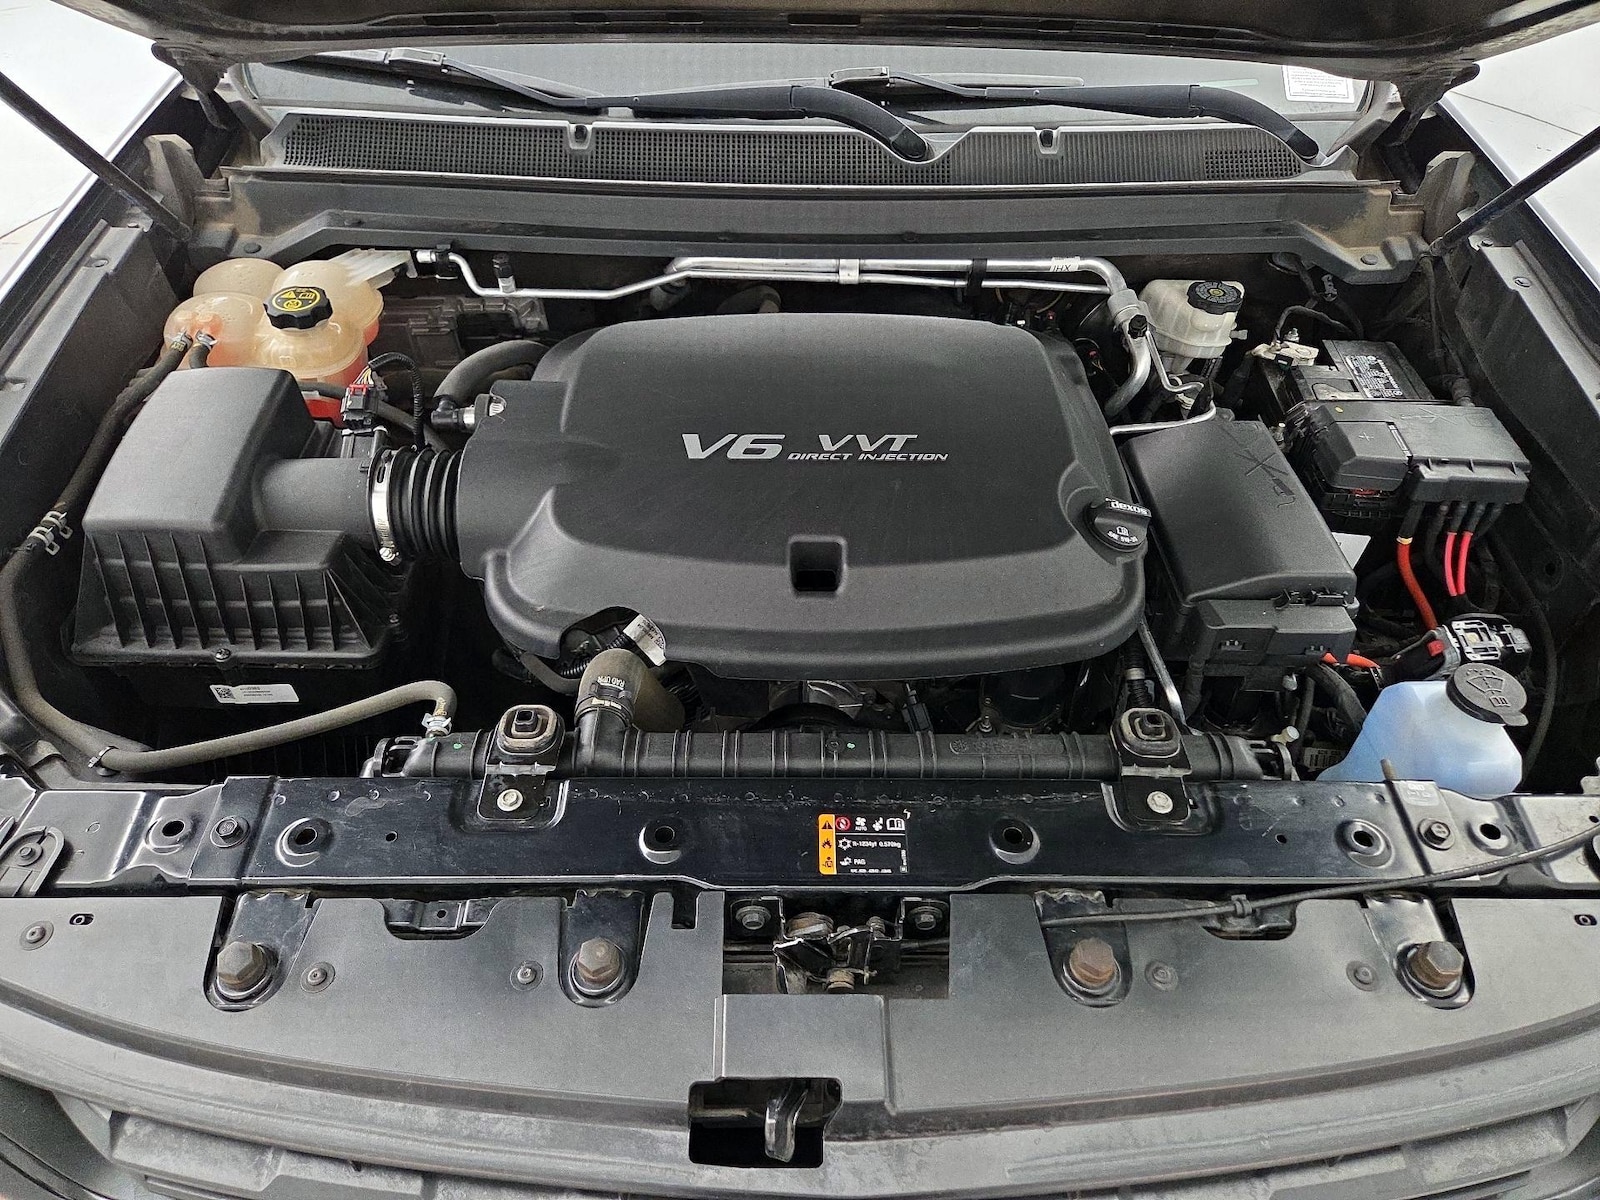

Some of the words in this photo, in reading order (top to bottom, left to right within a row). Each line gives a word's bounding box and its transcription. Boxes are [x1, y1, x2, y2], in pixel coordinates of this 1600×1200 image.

[682, 433, 786, 460] V6
[818, 434, 918, 451] VVT
[787, 453, 853, 461] DIRECT
[858, 453, 949, 461] INJECTION
[1110, 500, 1148, 515] dexos
